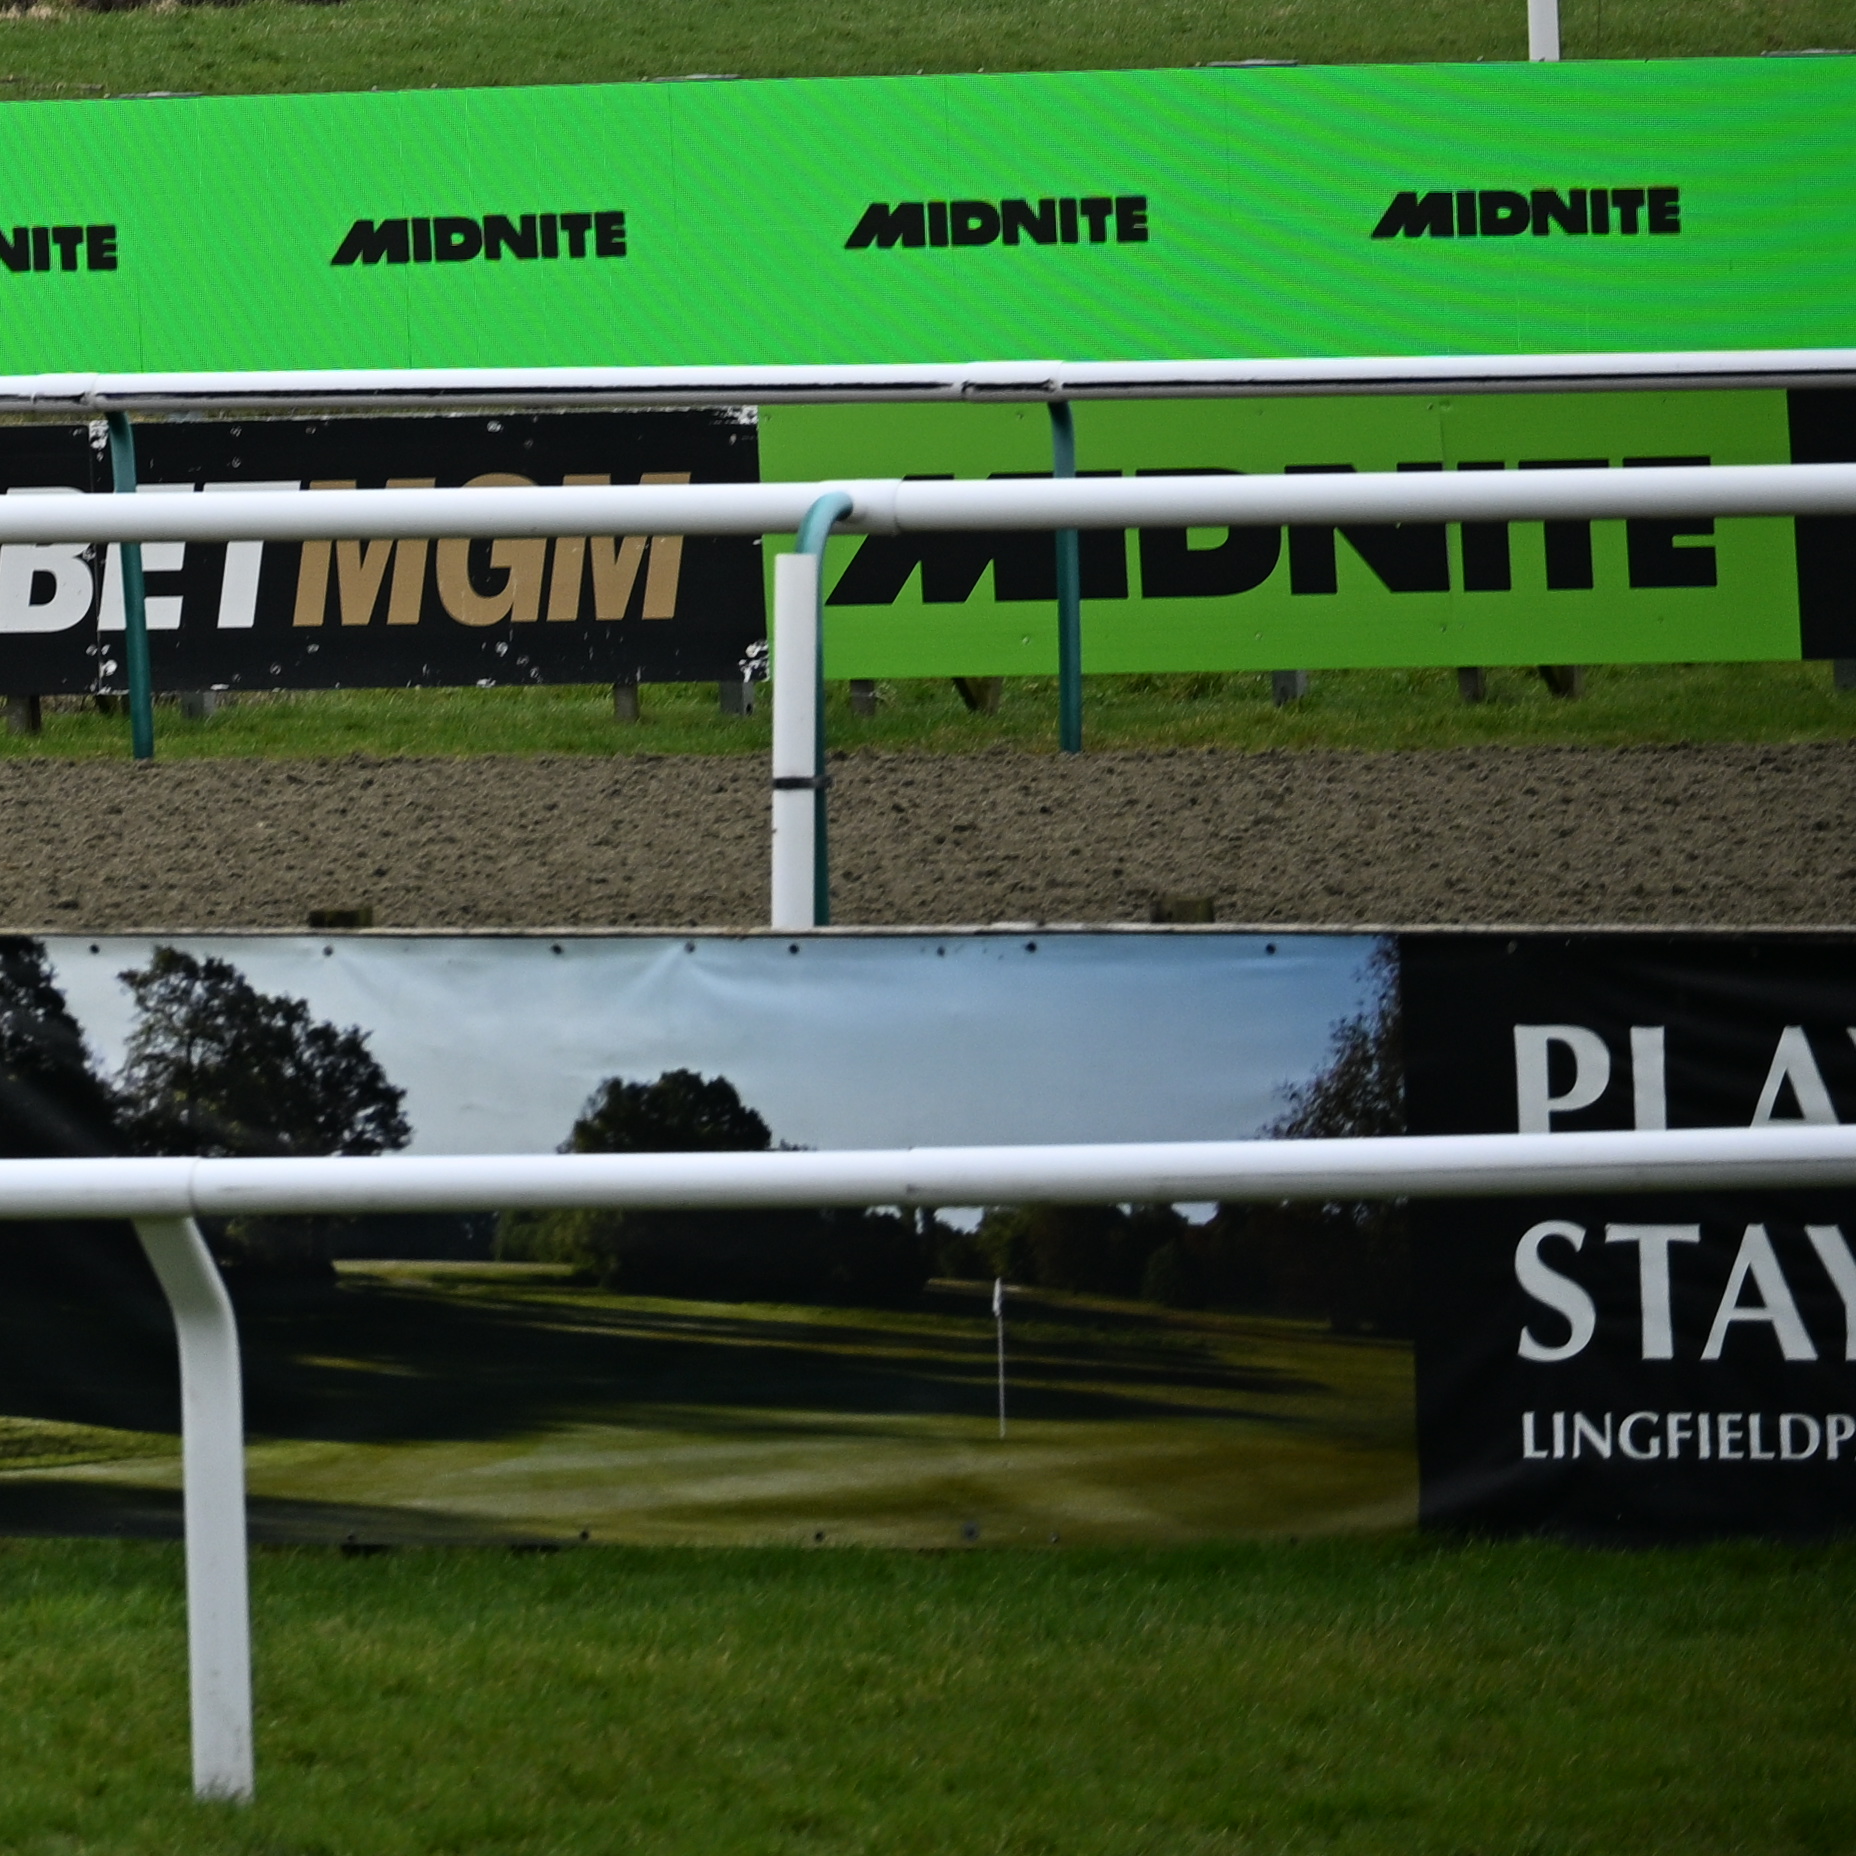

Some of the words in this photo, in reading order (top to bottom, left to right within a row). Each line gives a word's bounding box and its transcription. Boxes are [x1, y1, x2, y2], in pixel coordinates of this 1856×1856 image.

[330, 211, 627, 266] MIDNITE
[844, 195, 1148, 250] MIDNITE
[1371, 186, 1681, 239] MIDNITE
[825, 455, 1718, 607] MIDNITE
[1514, 1023, 1856, 1136] PLA
[1522, 1411, 1856, 1461] LINGFIELDP
